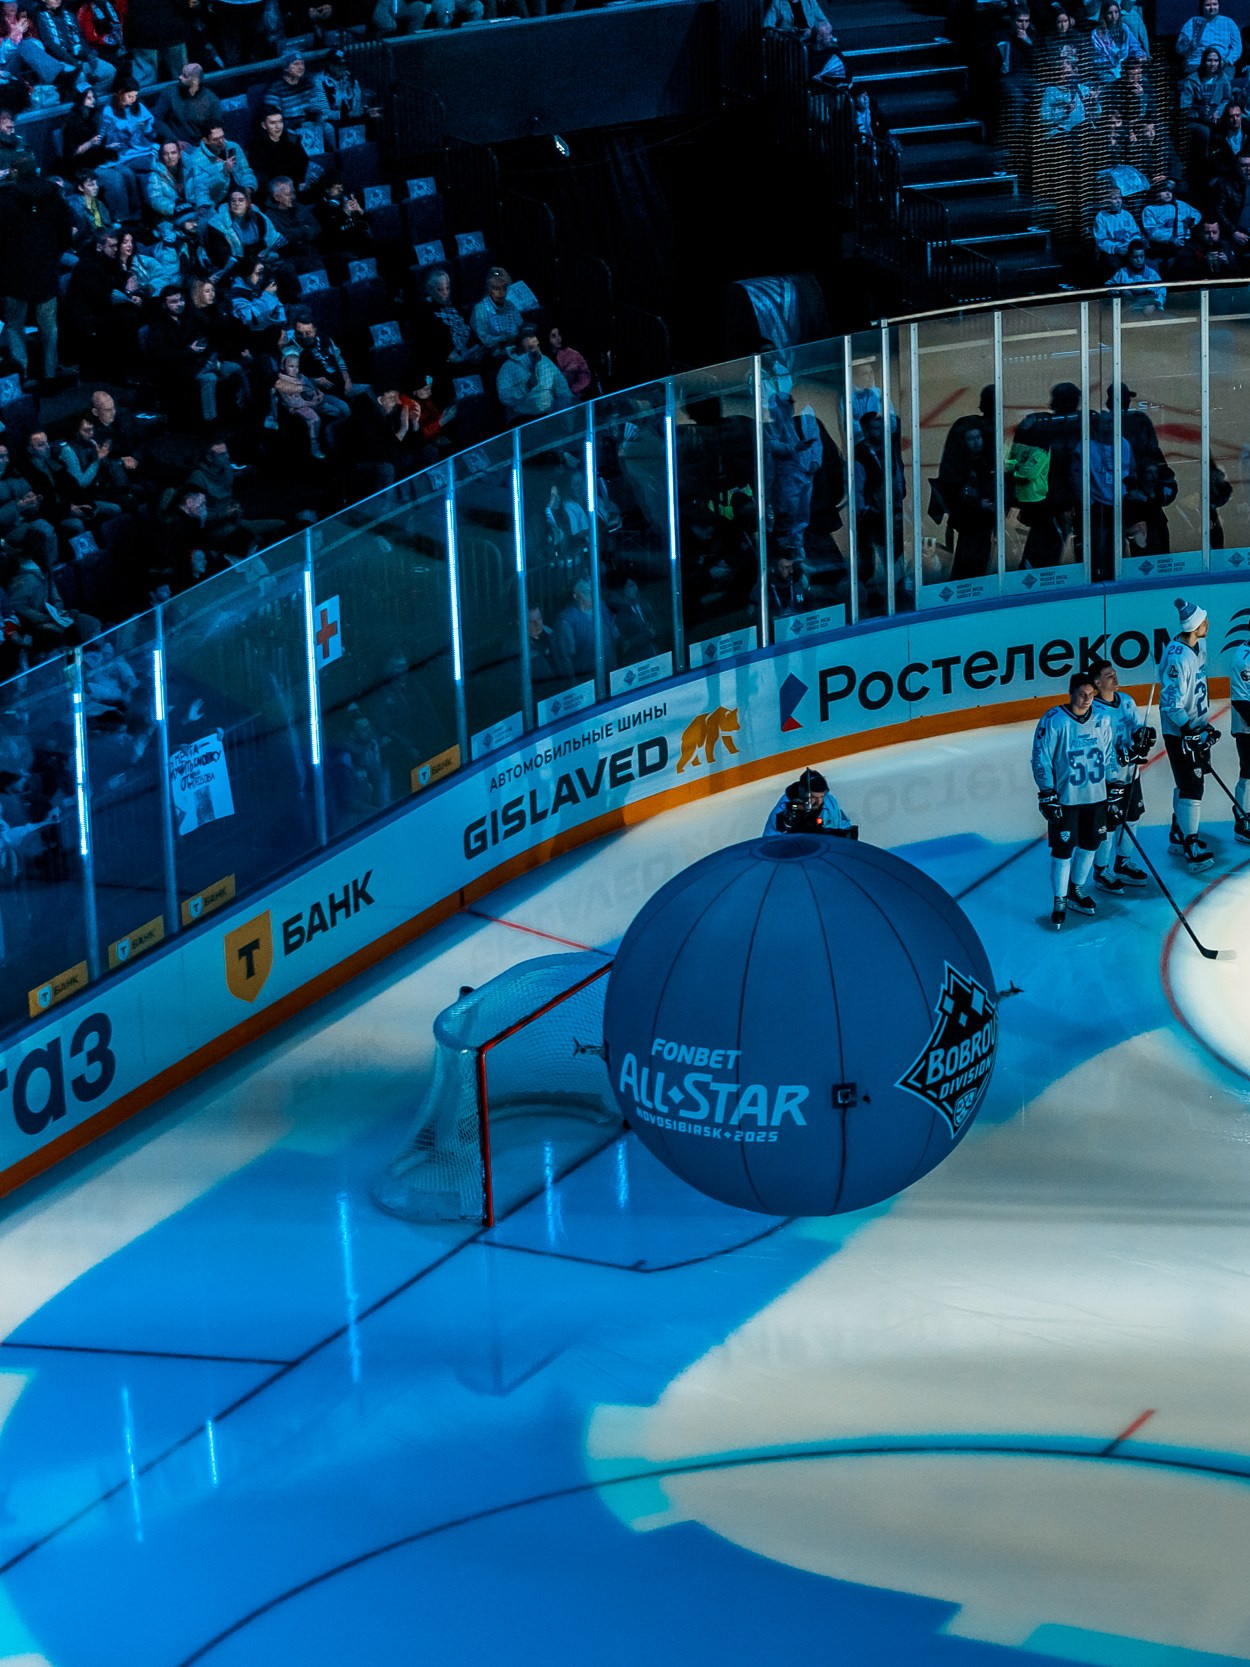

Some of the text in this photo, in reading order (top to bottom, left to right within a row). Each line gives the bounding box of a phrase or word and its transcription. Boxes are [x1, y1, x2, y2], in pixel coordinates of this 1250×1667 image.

[431, 757, 453, 775] БАНК
[489, 702, 667, 793] АВТОМОБИЛЬНЫЕ ШИНЫ
[1068, 747, 1105, 787] 53
[463, 735, 668, 861] GISLAVED
[282, 869, 375, 956] БАНК
[53, 974, 79, 997] БАНК
[651, 1038, 742, 1070] FONBET
[939, 1053, 993, 1100] DIVISION
[635, 1106, 779, 1142] NOVOSIBIRSK 2025
